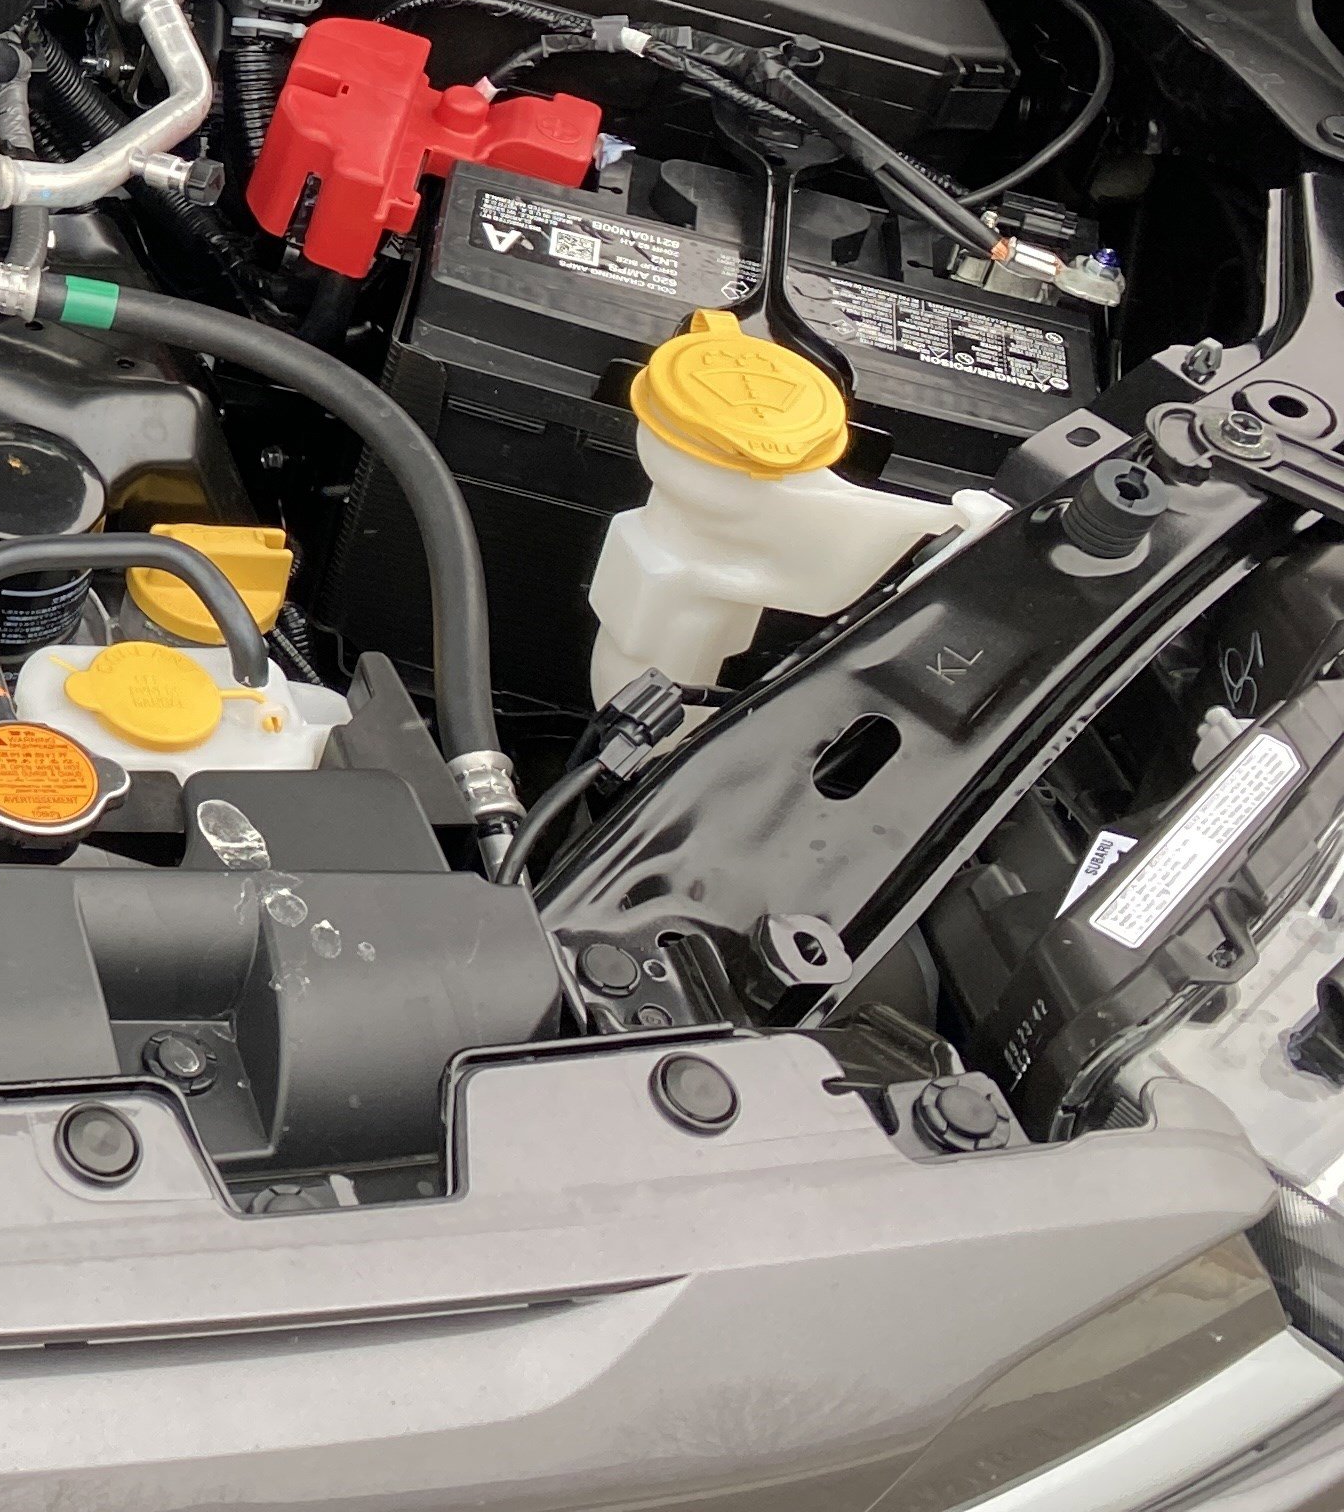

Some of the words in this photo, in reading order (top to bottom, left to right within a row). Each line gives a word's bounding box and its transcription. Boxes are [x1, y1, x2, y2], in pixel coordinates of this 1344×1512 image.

[618, 236, 635, 246] AH
[557, 258, 590, 273] AMPS
[614, 254, 639, 266] SIZE
[638, 260, 678, 276] GROUP
[649, 253, 679, 268] LN2
[588, 266, 646, 287] CRANKING
[606, 262, 650, 279] AMPS
[651, 273, 678, 286] 620
[645, 281, 677, 295] COLD
[918, 352, 1037, 389] DANGER/POISON
[747, 439, 798, 456] PULL
[925, 645, 985, 686] KL
[1084, 838, 1115, 877] SUBARU
